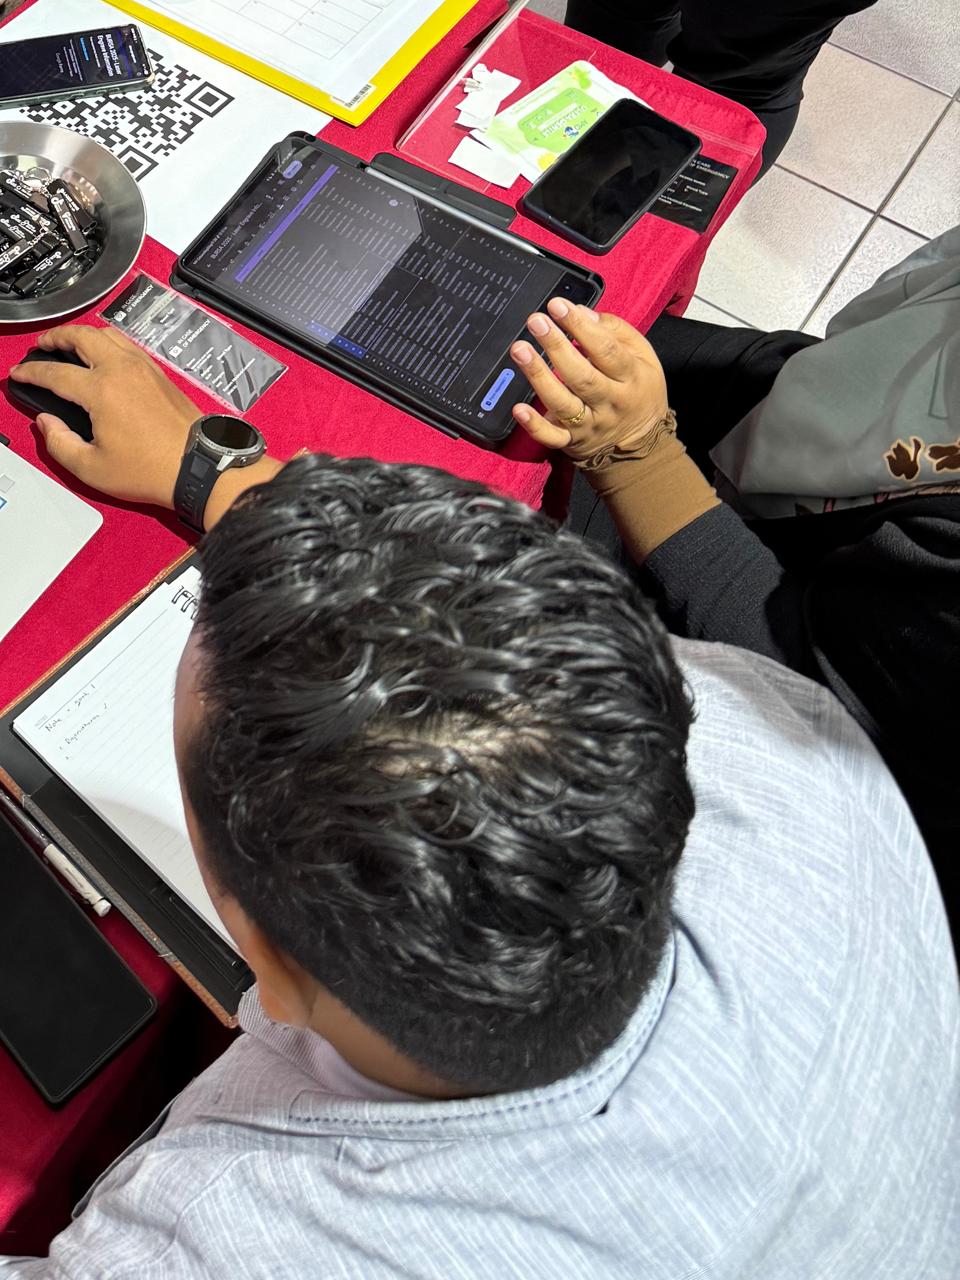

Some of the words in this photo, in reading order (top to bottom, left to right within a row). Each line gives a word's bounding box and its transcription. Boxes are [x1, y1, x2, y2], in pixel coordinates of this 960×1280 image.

[96, 34, 106, 52] Engrave
[101, 51, 112, 77] Information
[113, 62, 121, 75] Laser
[130, 283, 154, 307] EMERGENCY
[181, 328, 193, 339] CASE
[182, 340, 190, 348] OF
[187, 318, 211, 342] EMERGENCY
